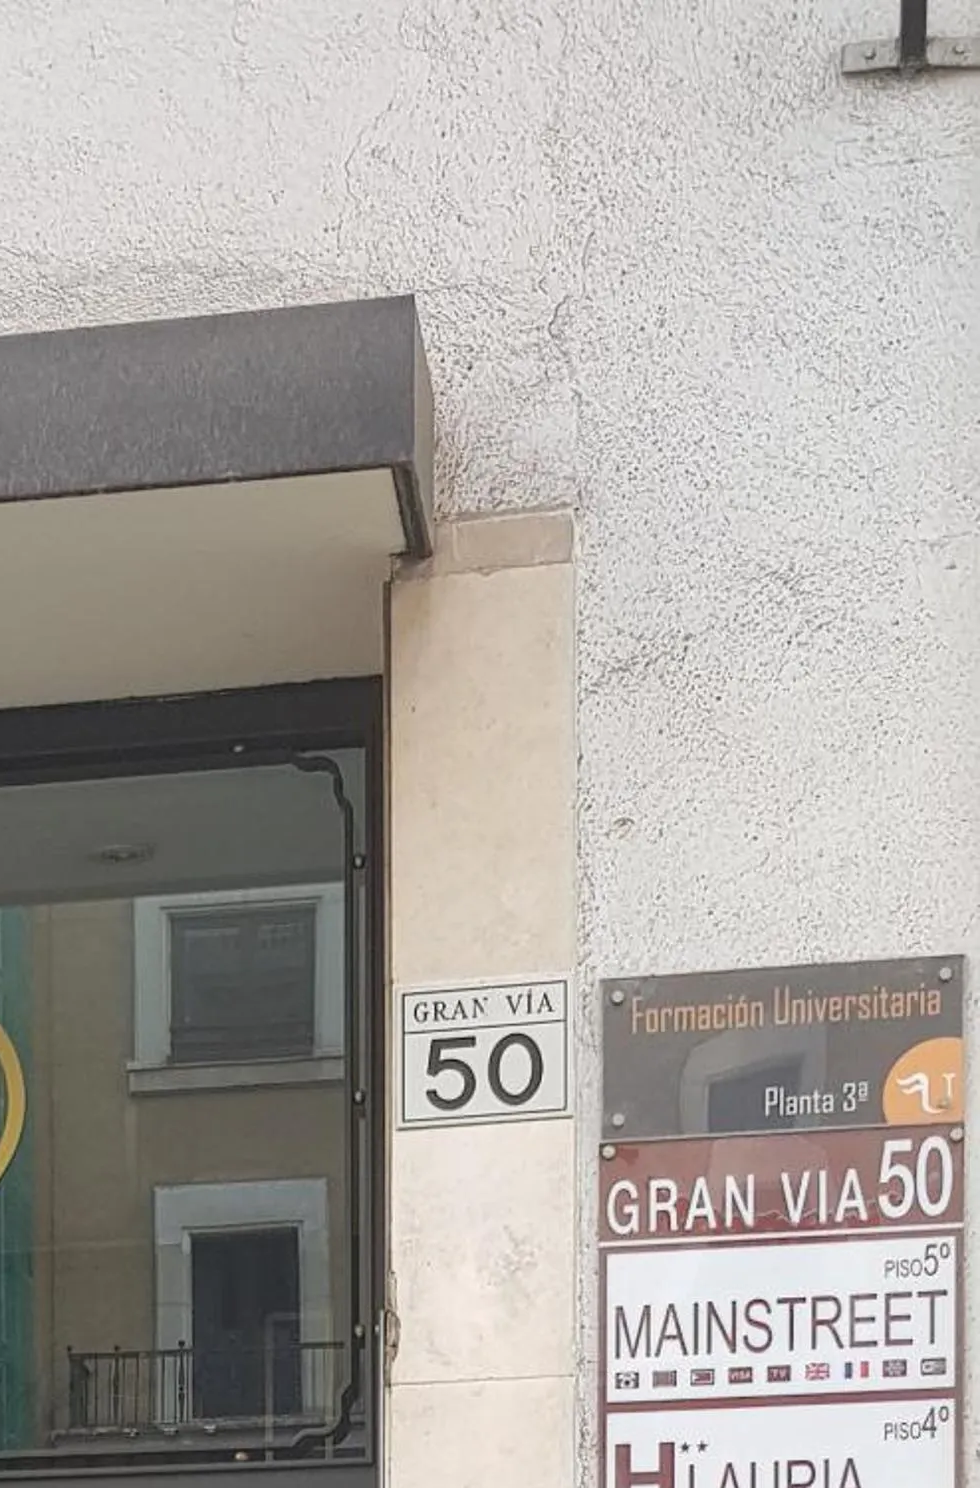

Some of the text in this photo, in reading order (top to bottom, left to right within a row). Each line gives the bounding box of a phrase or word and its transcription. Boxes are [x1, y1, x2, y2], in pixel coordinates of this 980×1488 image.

[413, 997, 489, 1024] GRAN
[630, 984, 942, 1035] Formación Universitaria
[426, 1032, 544, 1111] 50
[764, 1086, 834, 1117] Planta
[606, 1136, 954, 1235] GRAN VIA 50
[614, 1289, 948, 1360] MAINSTREET
